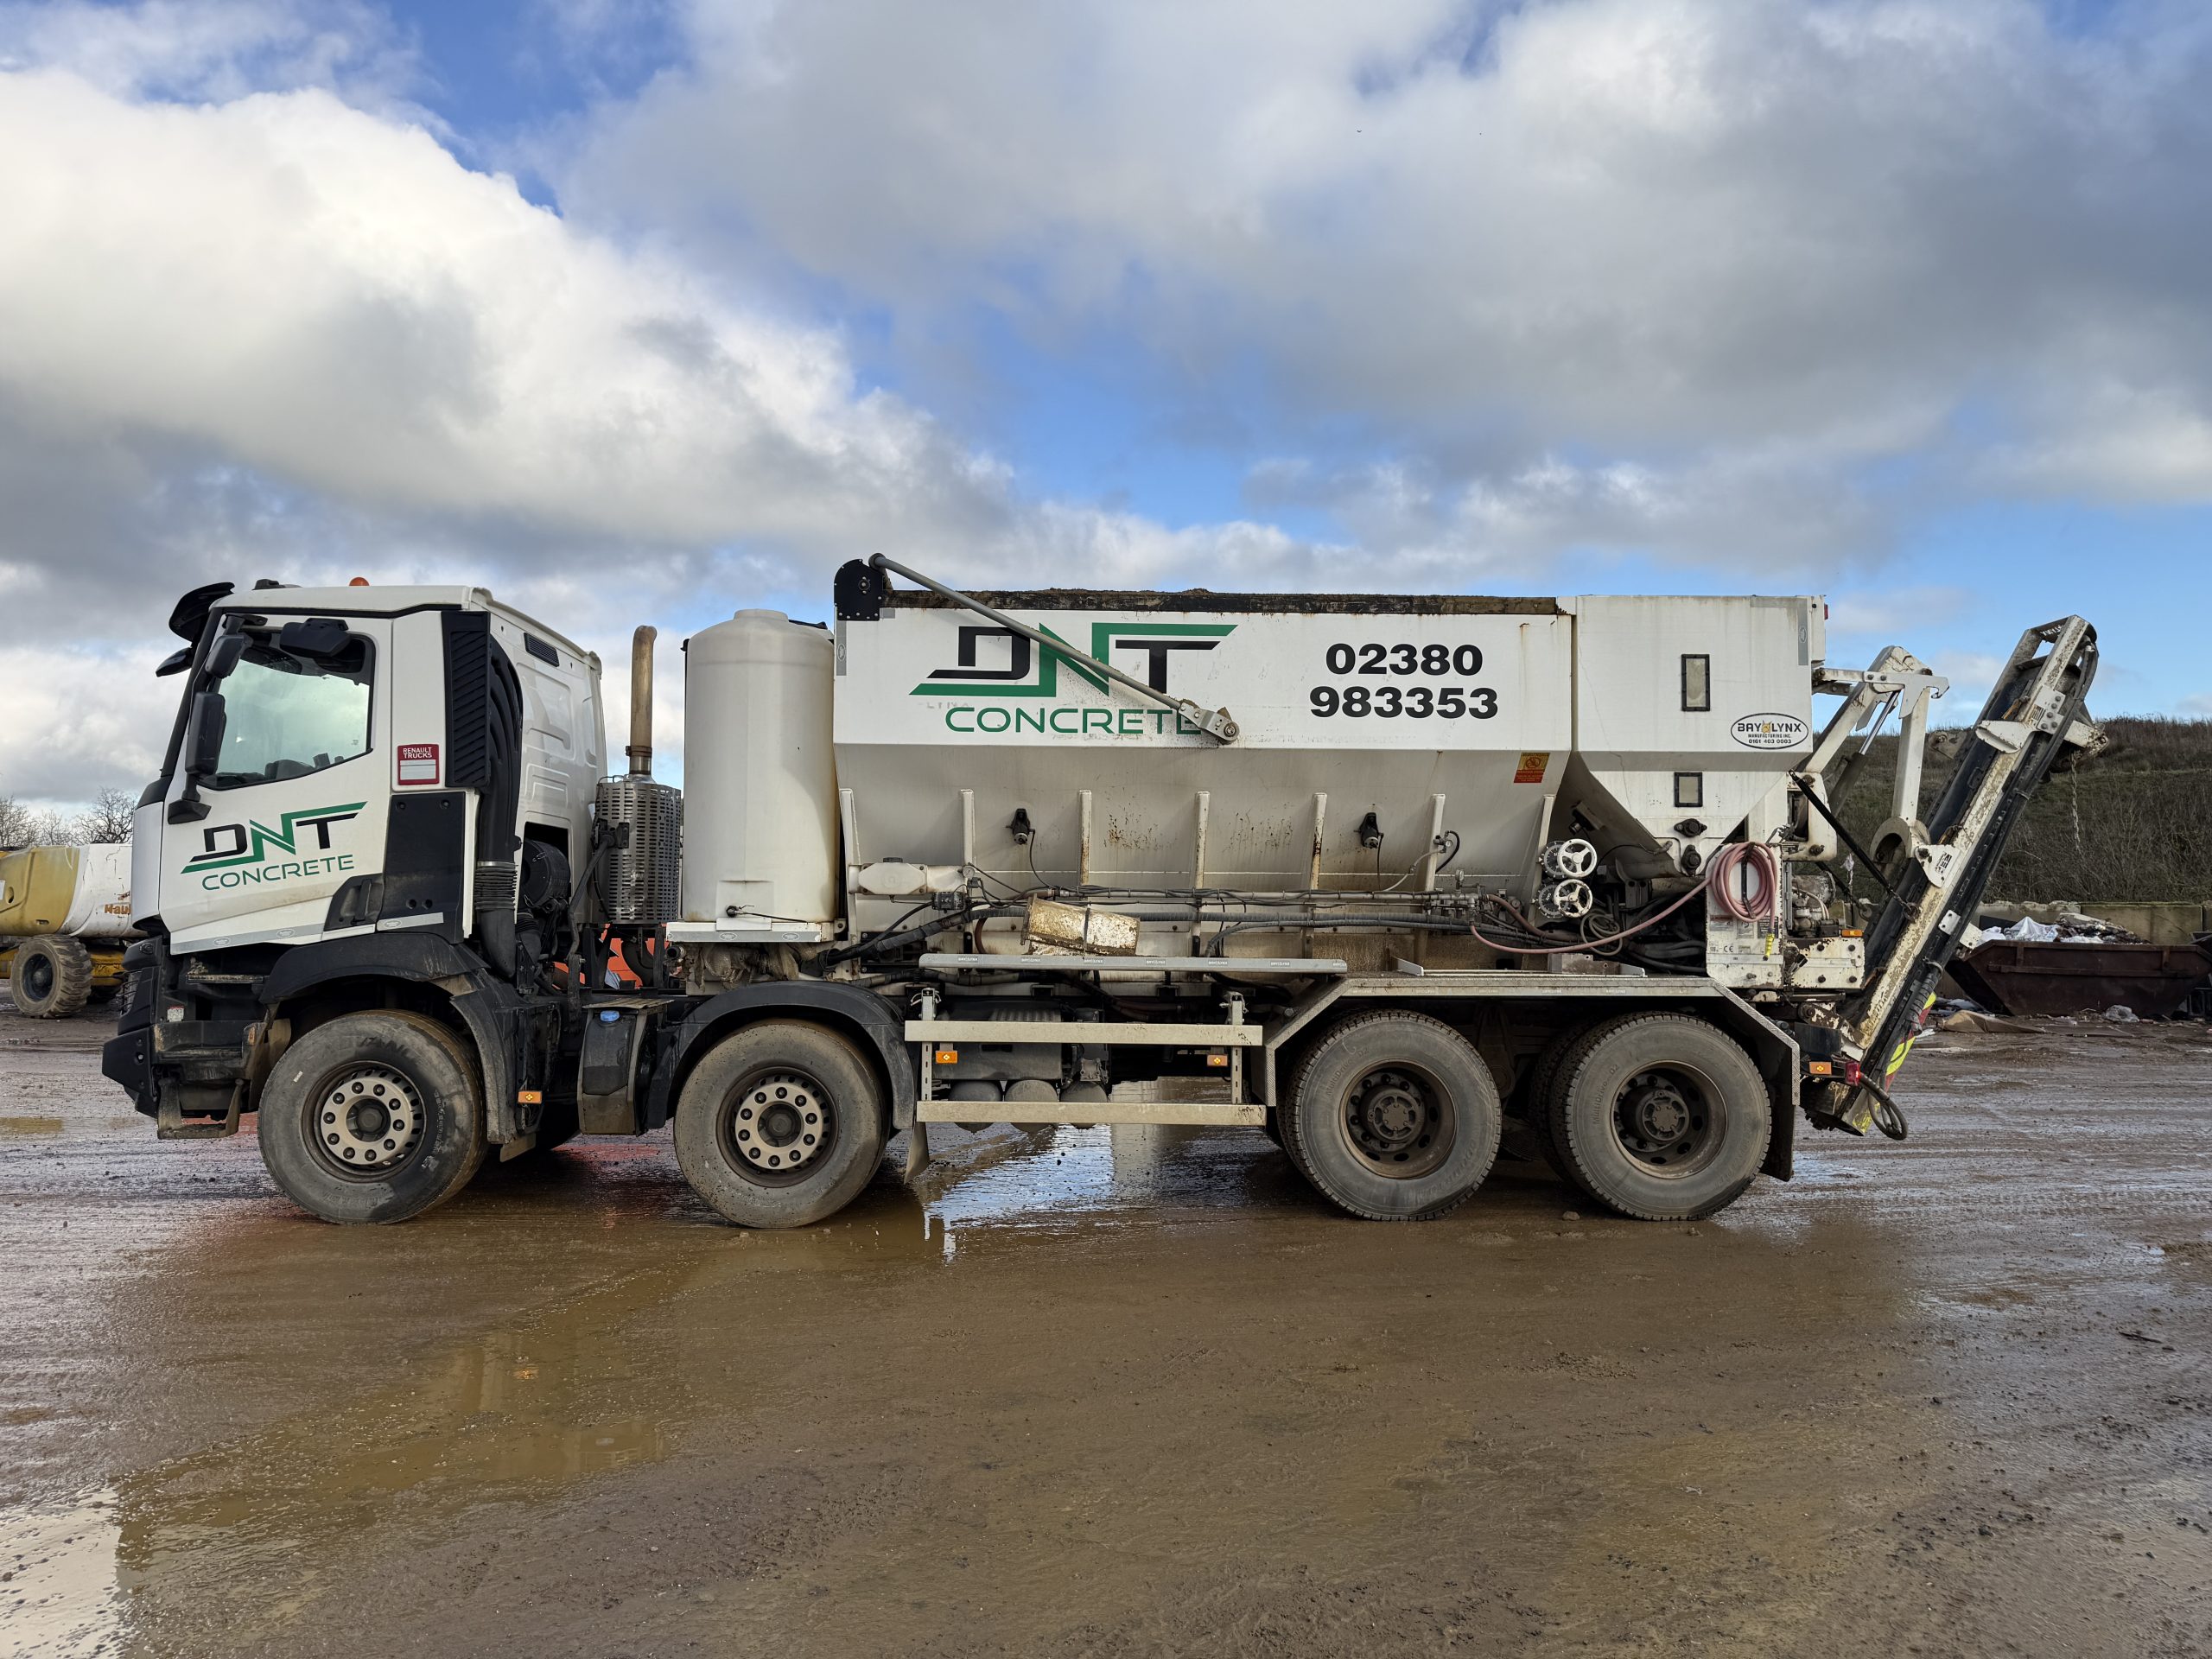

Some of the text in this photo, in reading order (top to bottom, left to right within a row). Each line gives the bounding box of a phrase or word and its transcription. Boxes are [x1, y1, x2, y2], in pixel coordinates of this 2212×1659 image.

[908, 622, 1239, 697] DNT
[1325, 643, 1484, 677] 02380
[1309, 685, 1499, 720] 983353
[1737, 722, 1802, 733] BAY LYNX
[181, 801, 368, 874] DNT
[201, 854, 355, 891] CONCRETE
